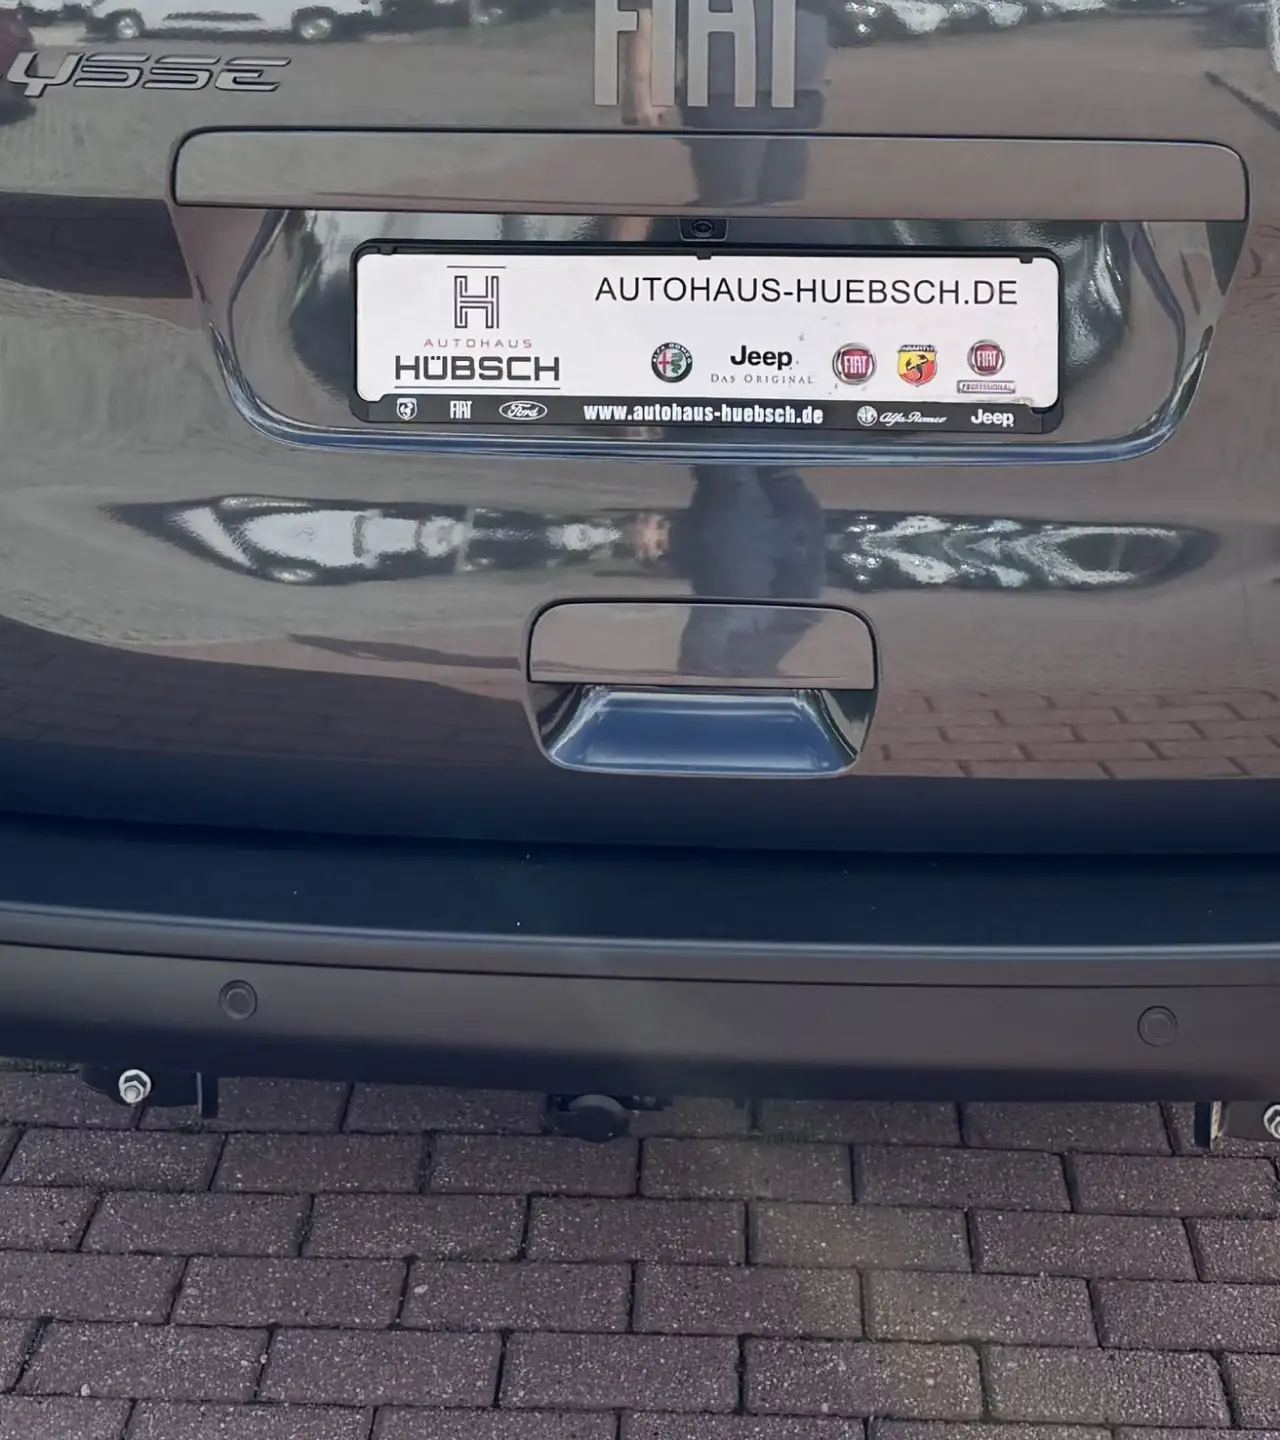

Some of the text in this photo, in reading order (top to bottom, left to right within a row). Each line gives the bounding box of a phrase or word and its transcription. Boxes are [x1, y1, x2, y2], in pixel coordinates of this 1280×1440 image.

[594, 276, 1018, 306] AUTOHAUS-HUEBSCH.DE
[423, 338, 534, 349] AUTOHAUS
[729, 345, 793, 371] Jeep
[843, 355, 868, 374] FIAT
[976, 351, 998, 367] FIAT
[394, 355, 560, 382] HÜBSCH
[449, 400, 473, 419] FIAT
[583, 402, 824, 424] www.autohaus-huebsch.de
[970, 408, 1014, 427] Jeep
